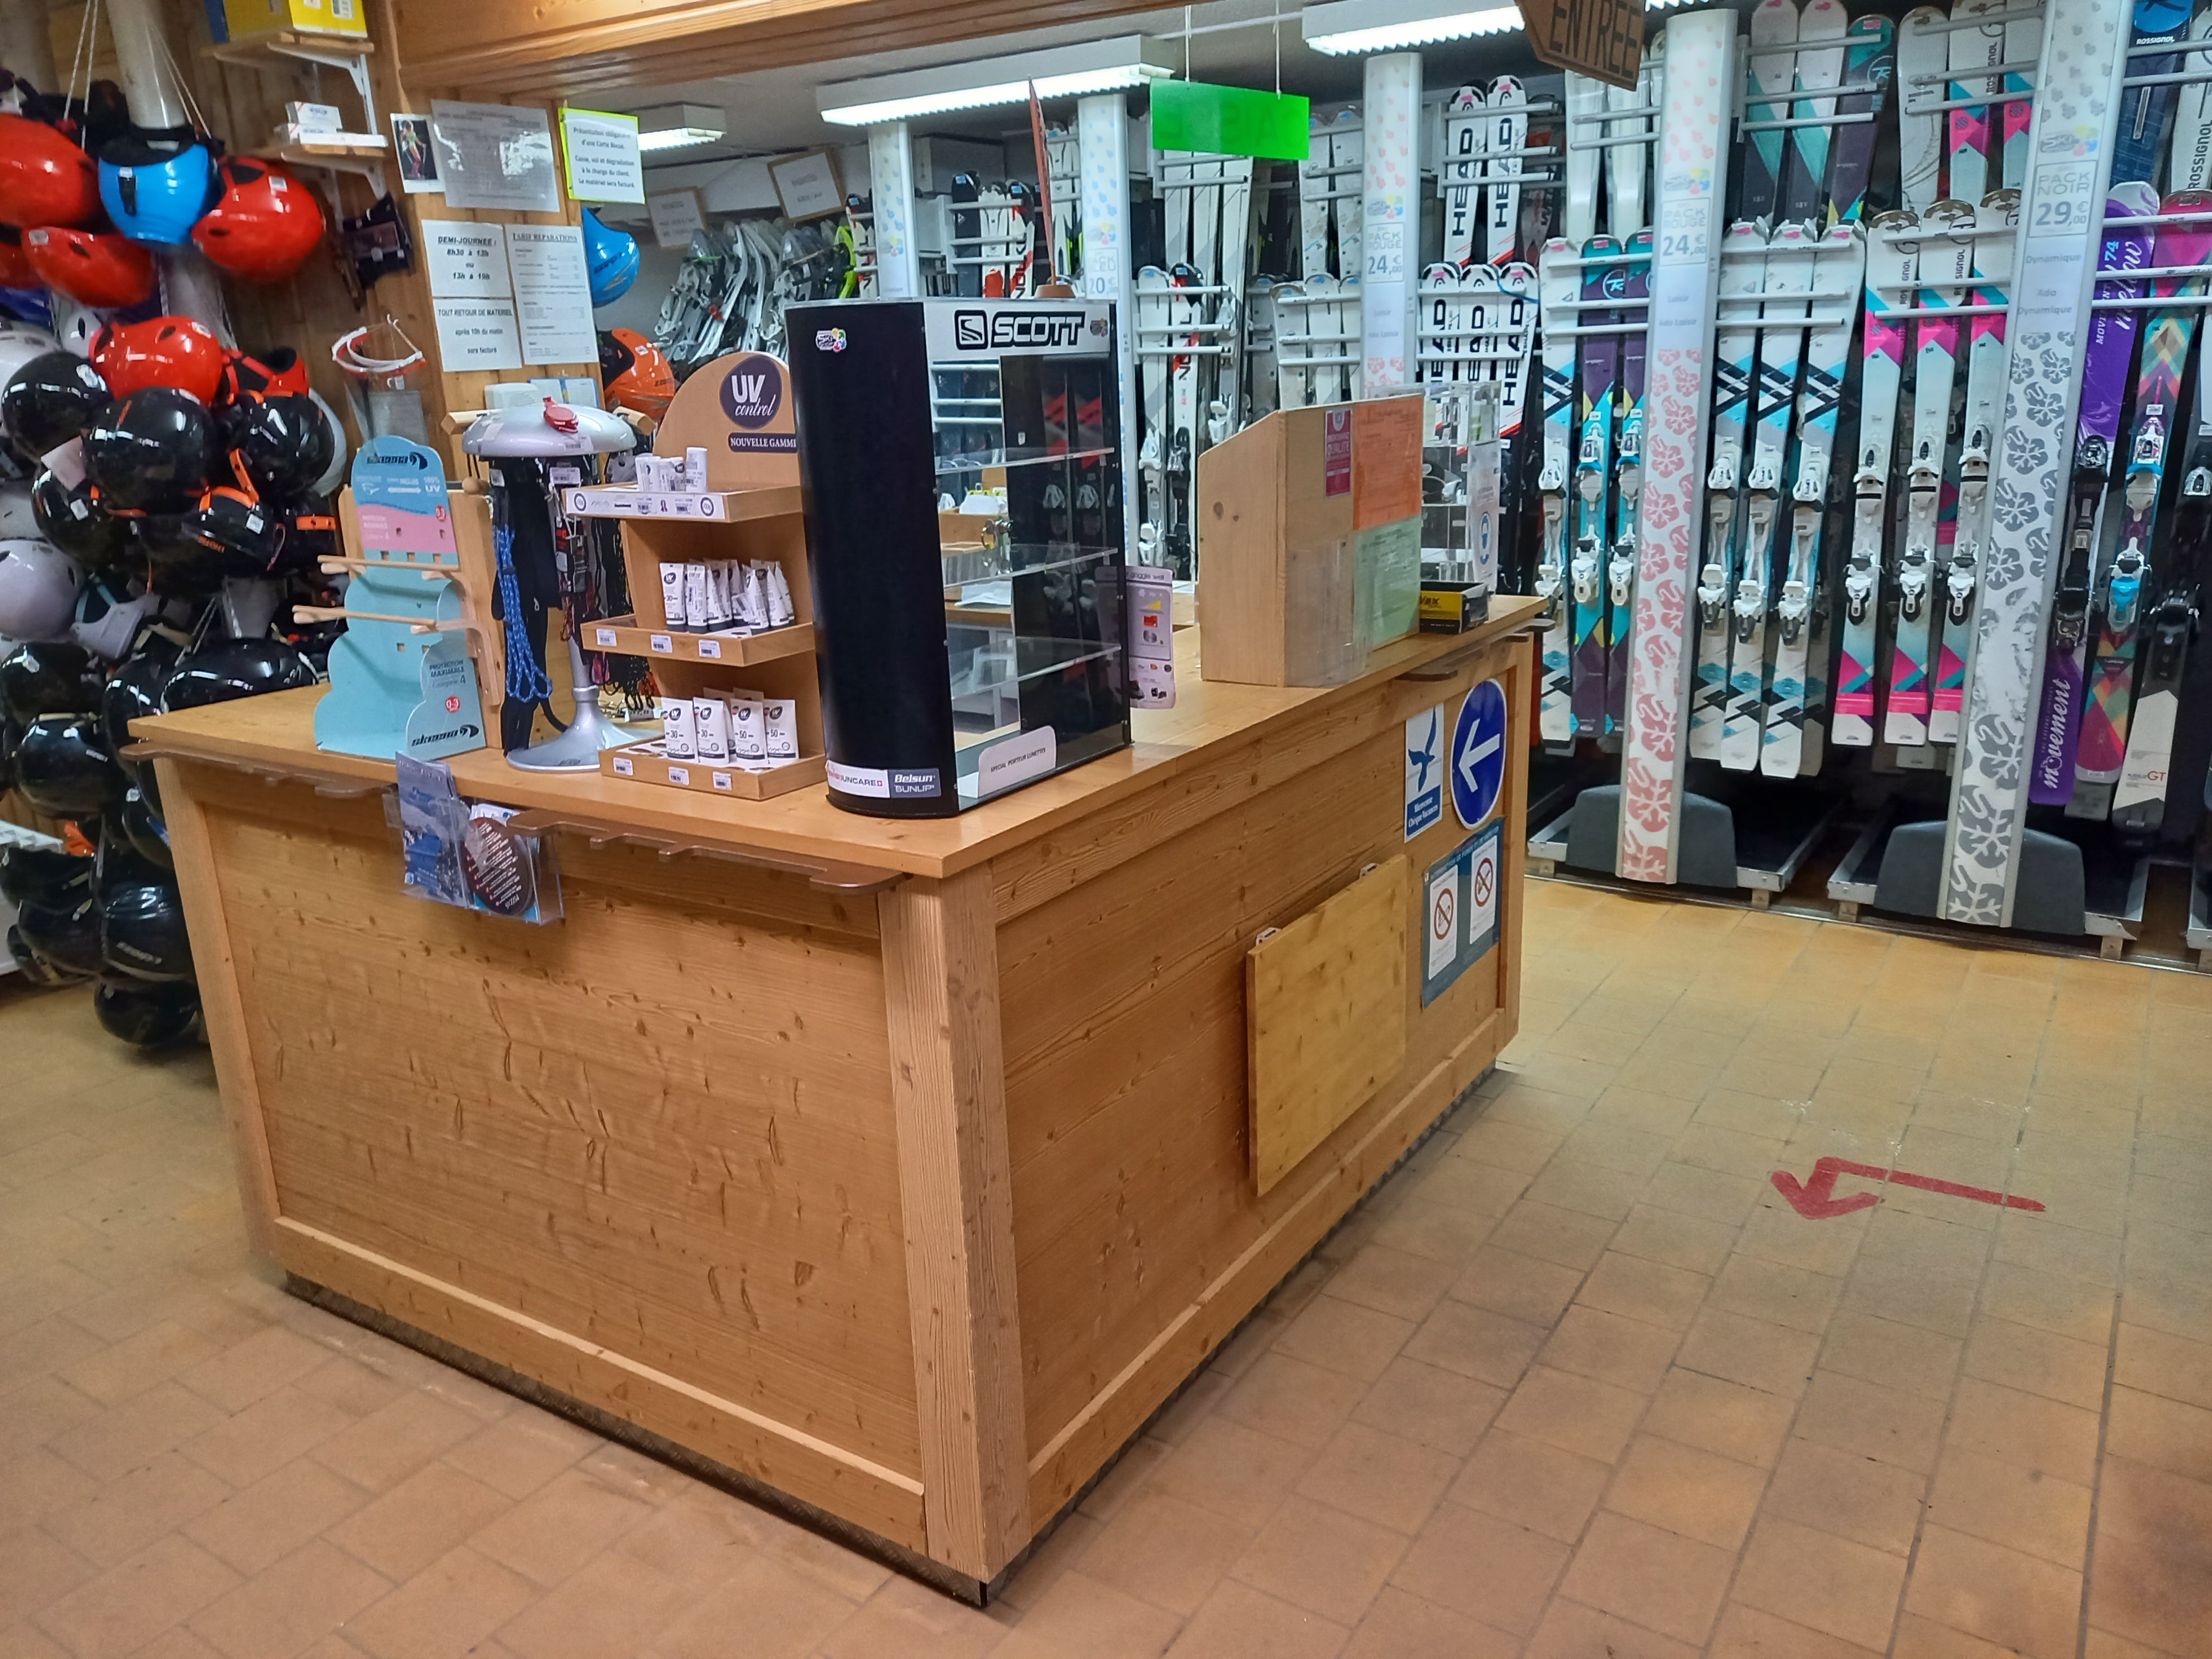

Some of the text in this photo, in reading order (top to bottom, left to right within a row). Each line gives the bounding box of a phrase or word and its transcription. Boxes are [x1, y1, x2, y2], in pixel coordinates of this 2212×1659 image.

[2136, 36, 2175, 45] ROSSIGNOL
[1986, 41, 1997, 95] ROSGNOL
[2039, 171, 2091, 183] PACK
[2037, 182, 2090, 196] NOIR
[2026, 254, 2081, 264] Dynamique
[2037, 289, 2057, 297] Ado
[2018, 305, 2073, 316] Dynamique
[992, 311, 1086, 348] SCOTT
[1502, 299, 1524, 406] HEAD
[732, 374, 766, 403] UV
[735, 394, 776, 416] control
[730, 437, 768, 447] NOUVELLE
[2043, 678, 2071, 789] movement
[2147, 770, 2166, 781] GT
